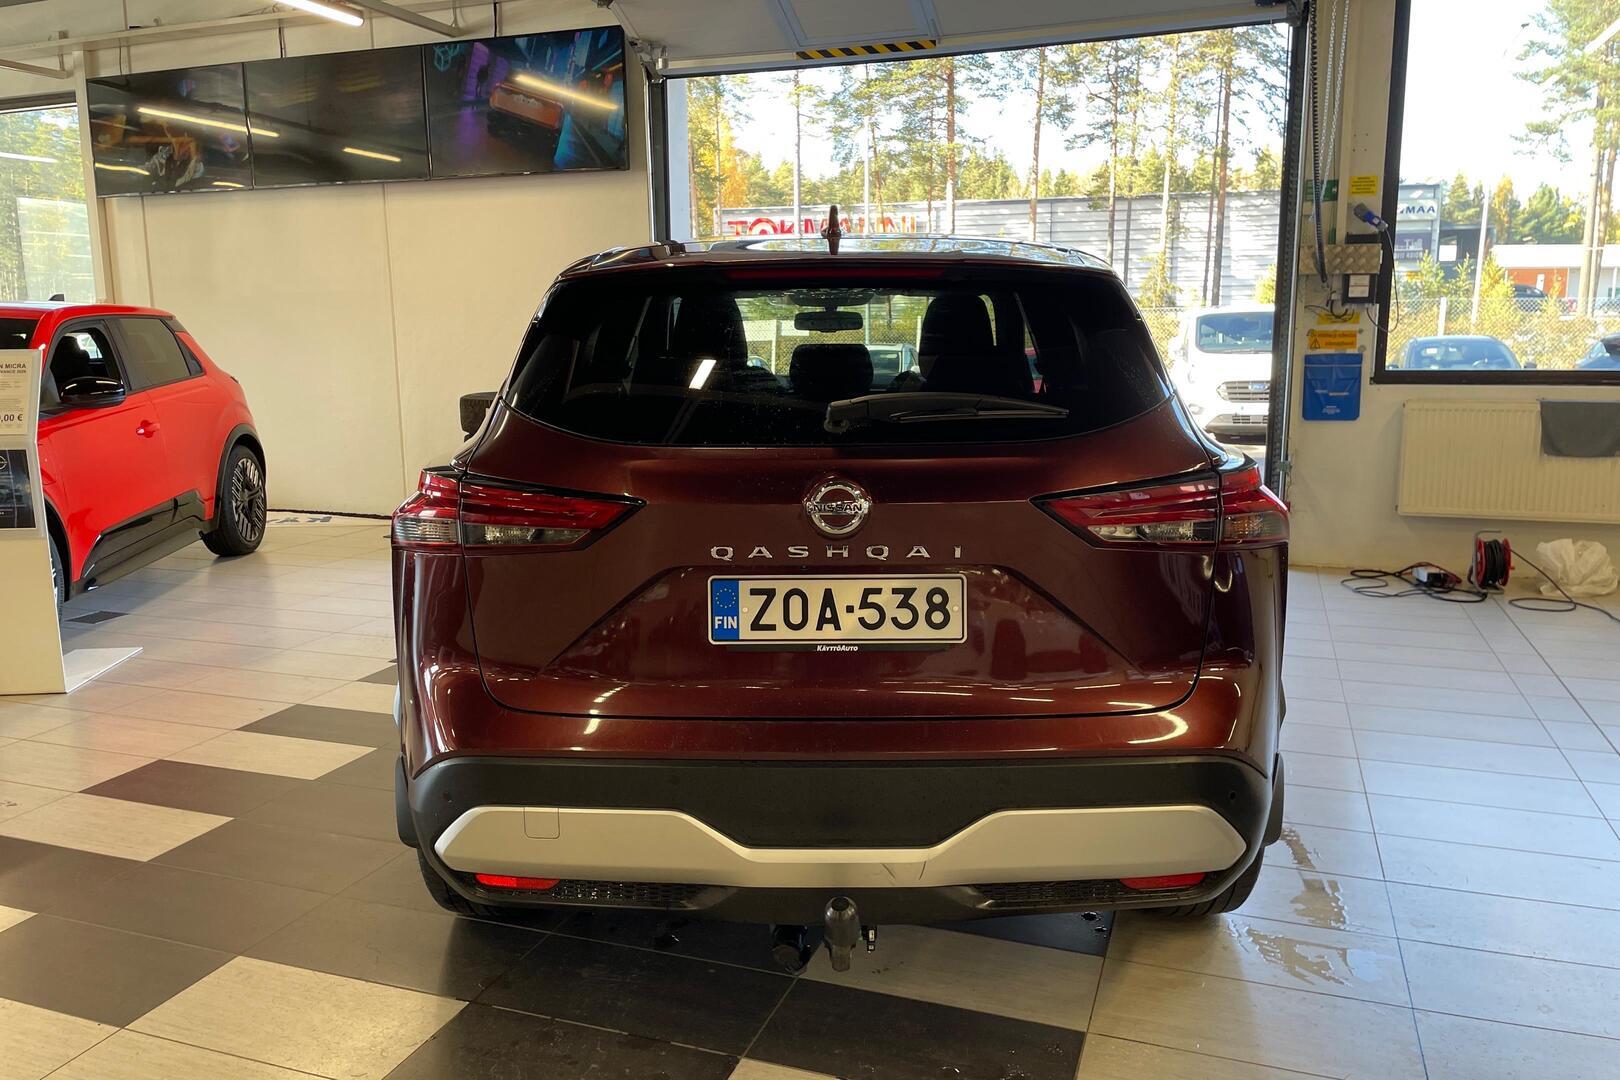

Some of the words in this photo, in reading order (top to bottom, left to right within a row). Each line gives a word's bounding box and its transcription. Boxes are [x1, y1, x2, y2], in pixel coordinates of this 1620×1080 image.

[813, 503, 863, 513] NISSAN
[710, 545, 962, 561] QASHQAI
[749, 587, 951, 632] ZOA-538
[714, 616, 738, 630] FIN
